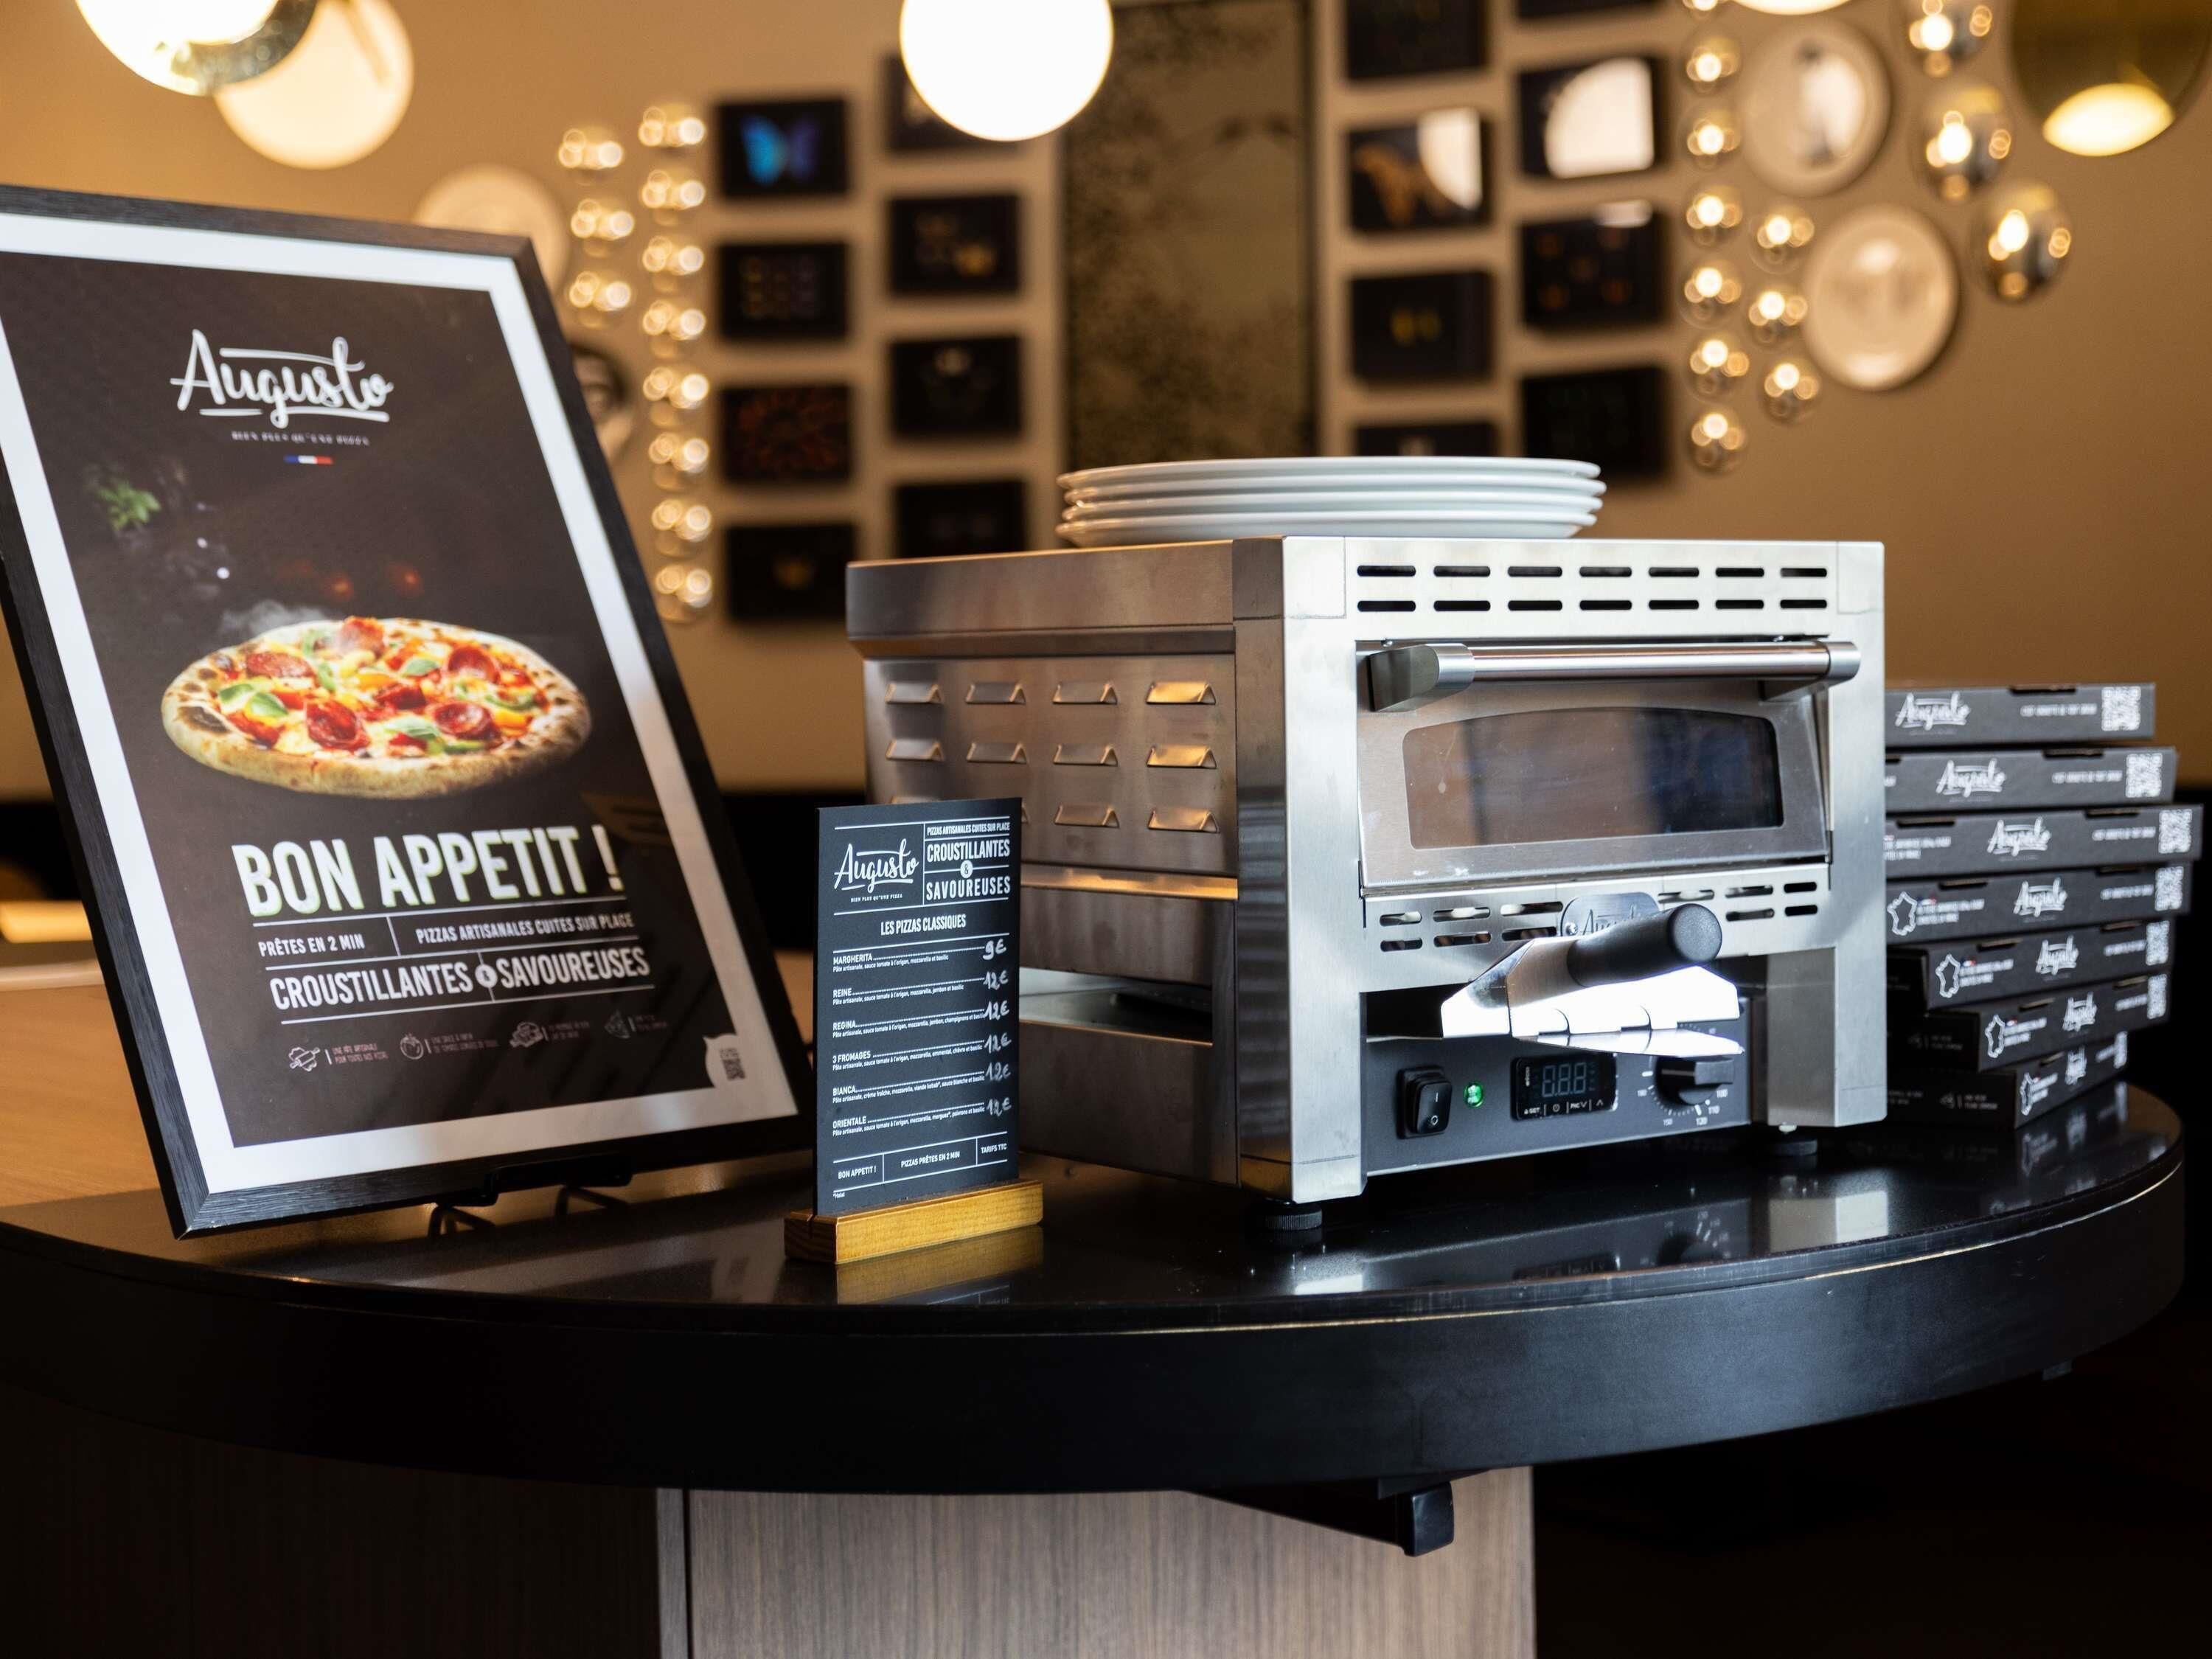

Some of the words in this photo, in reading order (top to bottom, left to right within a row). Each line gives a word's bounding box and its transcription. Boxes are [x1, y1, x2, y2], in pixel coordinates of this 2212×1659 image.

[170, 328, 394, 429] Augusto
[928, 826, 942, 836] PIZZAS
[943, 824, 971, 835] ARTISANALES
[972, 823, 986, 832] CUITES
[987, 822, 995, 832] SUR
[996, 821, 1009, 831] PLACE
[928, 838, 1009, 862] CROUSTILLANTES
[232, 838, 364, 917] BON
[372, 825, 588, 908] APPETIT
[591, 824, 625, 891] !
[834, 838, 919, 893] Augusto
[926, 875, 1010, 901] SAVOUREUSES
[415, 925, 459, 945] PIZZAS
[459, 919, 535, 941] ARTISANALES
[536, 918, 574, 936] CUITES
[576, 916, 597, 931] SUR
[598, 912, 636, 930] PLACE
[880, 920, 894, 936] LES
[896, 918, 921, 933] PIZZAS
[922, 914, 966, 931] CLASSIQUES
[258, 933, 307, 957] PRÊTES
[307, 936, 327, 954] EN
[327, 936, 338, 952] 2
[339, 933, 366, 950] MIN
[983, 939, 1006, 959] 9€
[833, 953, 872, 964] MARGHERITA
[269, 961, 473, 1011] CROUSTILLANTES
[498, 947, 650, 989] SAVOUREUSES
[983, 970, 1008, 989] 12€
[832, 987, 852, 998] REINE
[984, 1001, 1009, 1020] 12€
[832, 1020, 855, 1030] REGINA
[984, 1032, 1011, 1051] 12€
[838, 1050, 870, 1062] FROMAGES
[985, 1061, 1010, 1082] 12€
[832, 1085, 855, 1096] BIANCA
[986, 1097, 1011, 1116] 12€
[832, 1116, 866, 1128] ORIENTALE
[981, 1144, 997, 1153] TARIFS
[901, 1158, 918, 1167] PIZZAS
[919, 1153, 937, 1164] PRÊTES
[838, 1169, 849, 1179] BON
[851, 1166, 872, 1177] APPETIT
